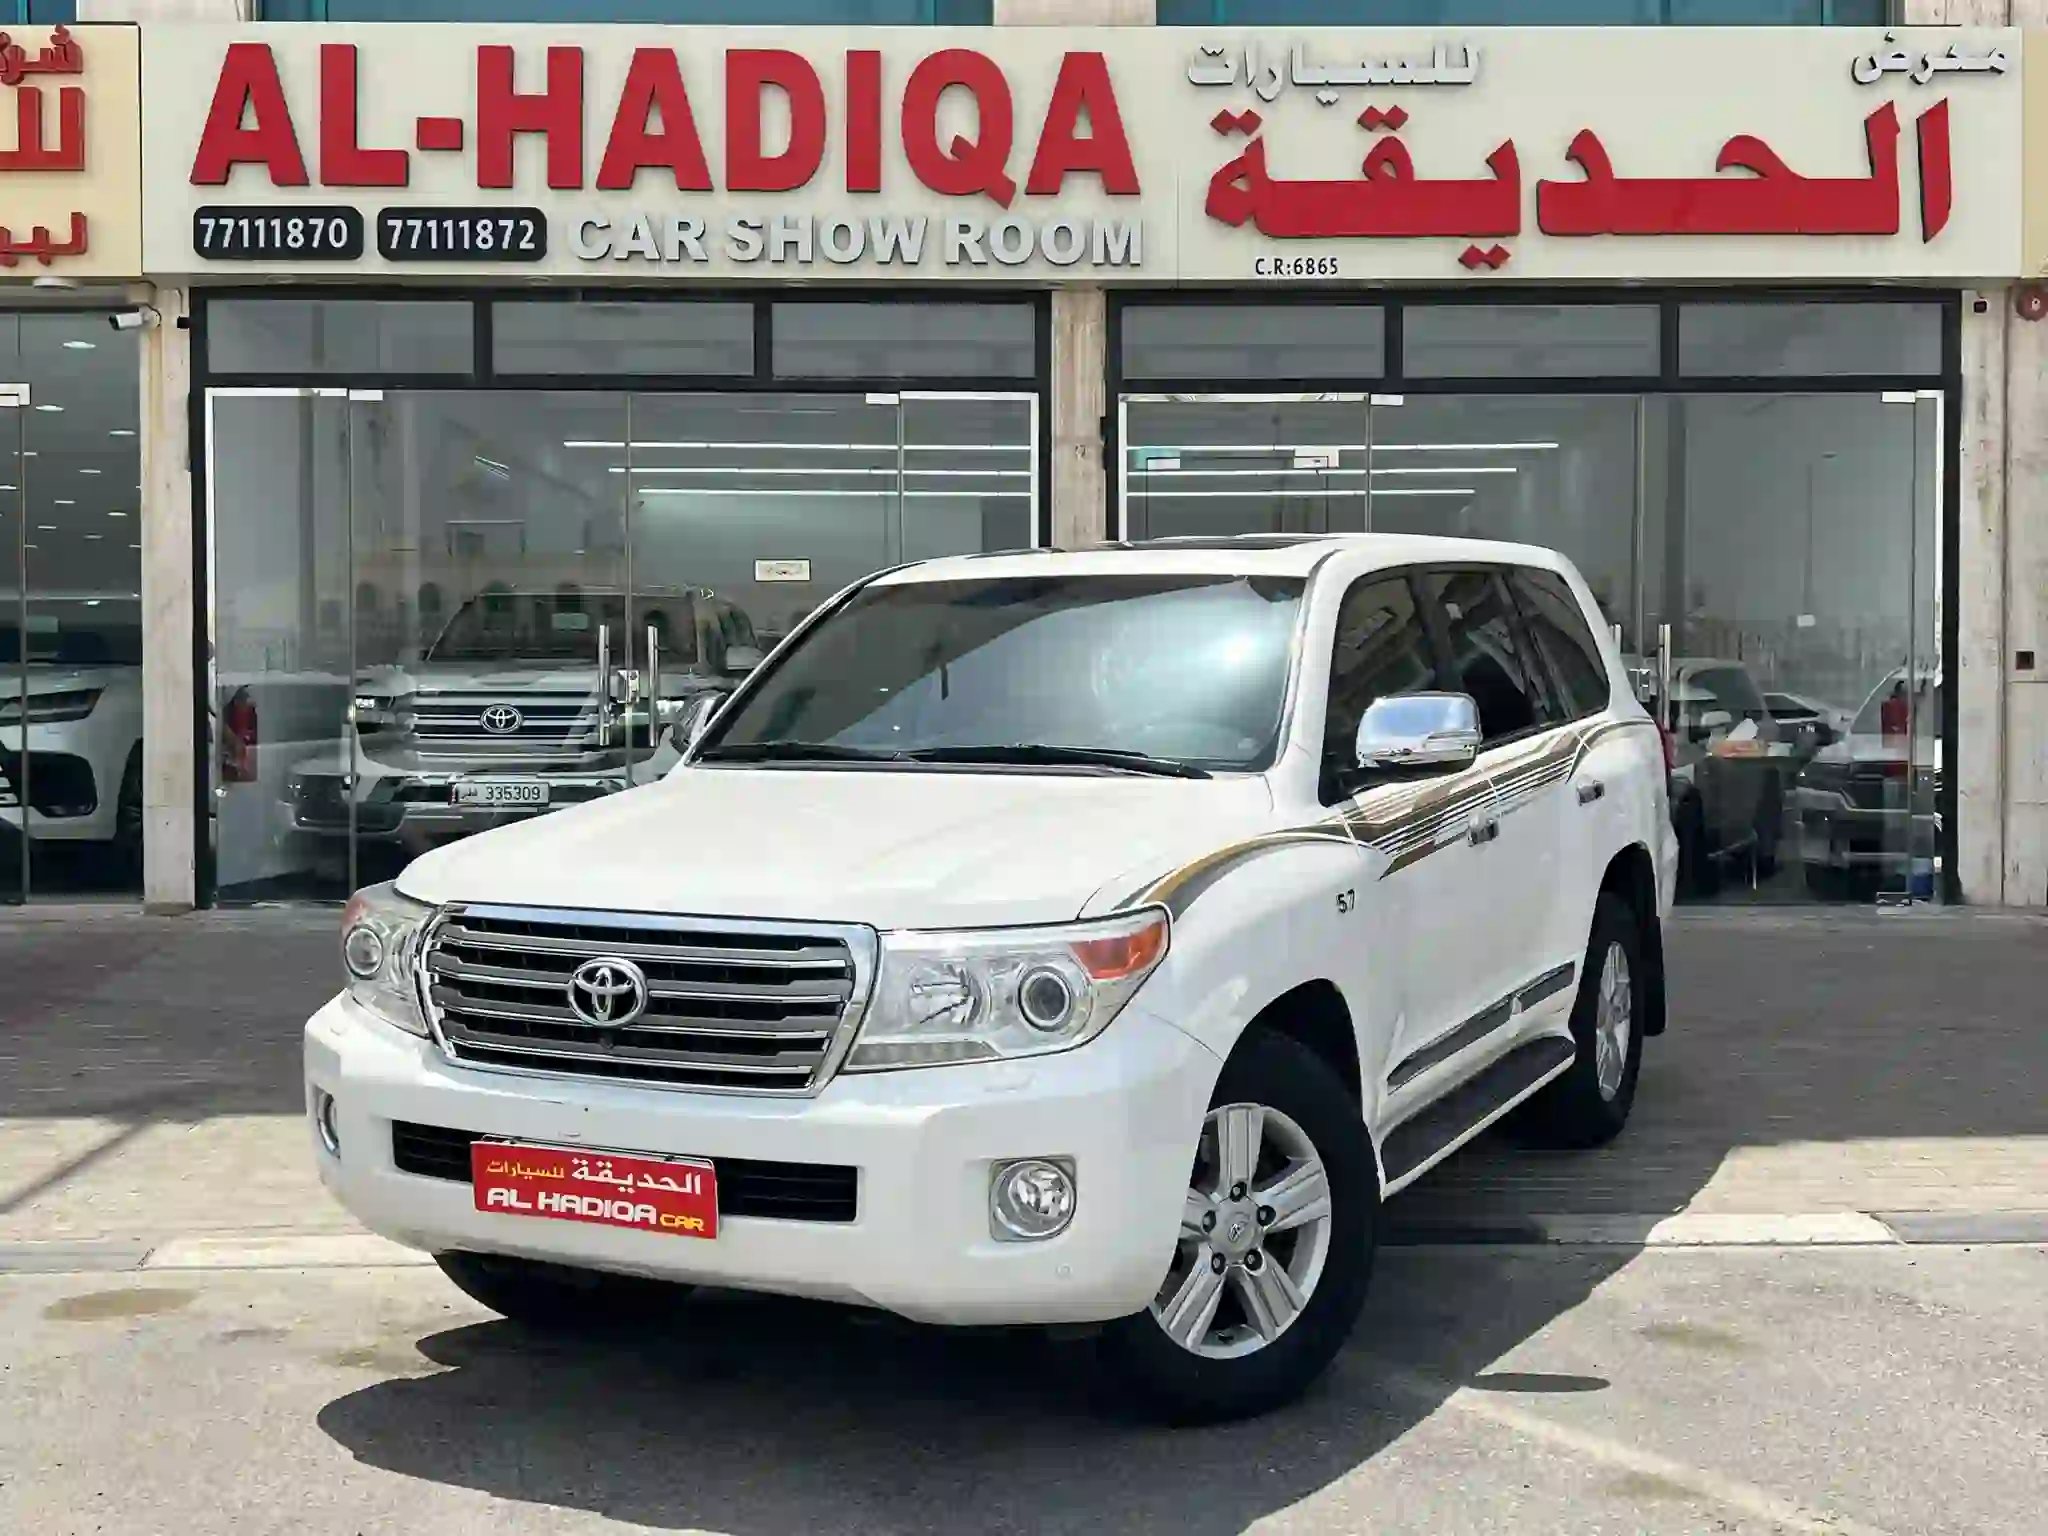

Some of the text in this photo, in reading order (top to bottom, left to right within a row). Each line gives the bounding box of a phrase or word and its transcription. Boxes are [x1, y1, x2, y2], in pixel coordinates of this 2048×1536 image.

[1188, 43, 1479, 106] للسيارات
[1851, 32, 2006, 86] معرض
[189, 42, 1142, 210] AL-HADIQA
[1205, 97, 1953, 270] الحديقة
[199, 217, 349, 249] 77111870
[386, 219, 536, 250] 77111872
[568, 213, 1143, 268] CAR SHOW ROOM
[1255, 257, 1339, 276] C.R:6865
[485, 785, 541, 801] 335309
[486, 1157, 701, 1195] الحديقة للسيارات
[486, 1187, 532, 1210] AL
[659, 1212, 705, 1232] CAR
